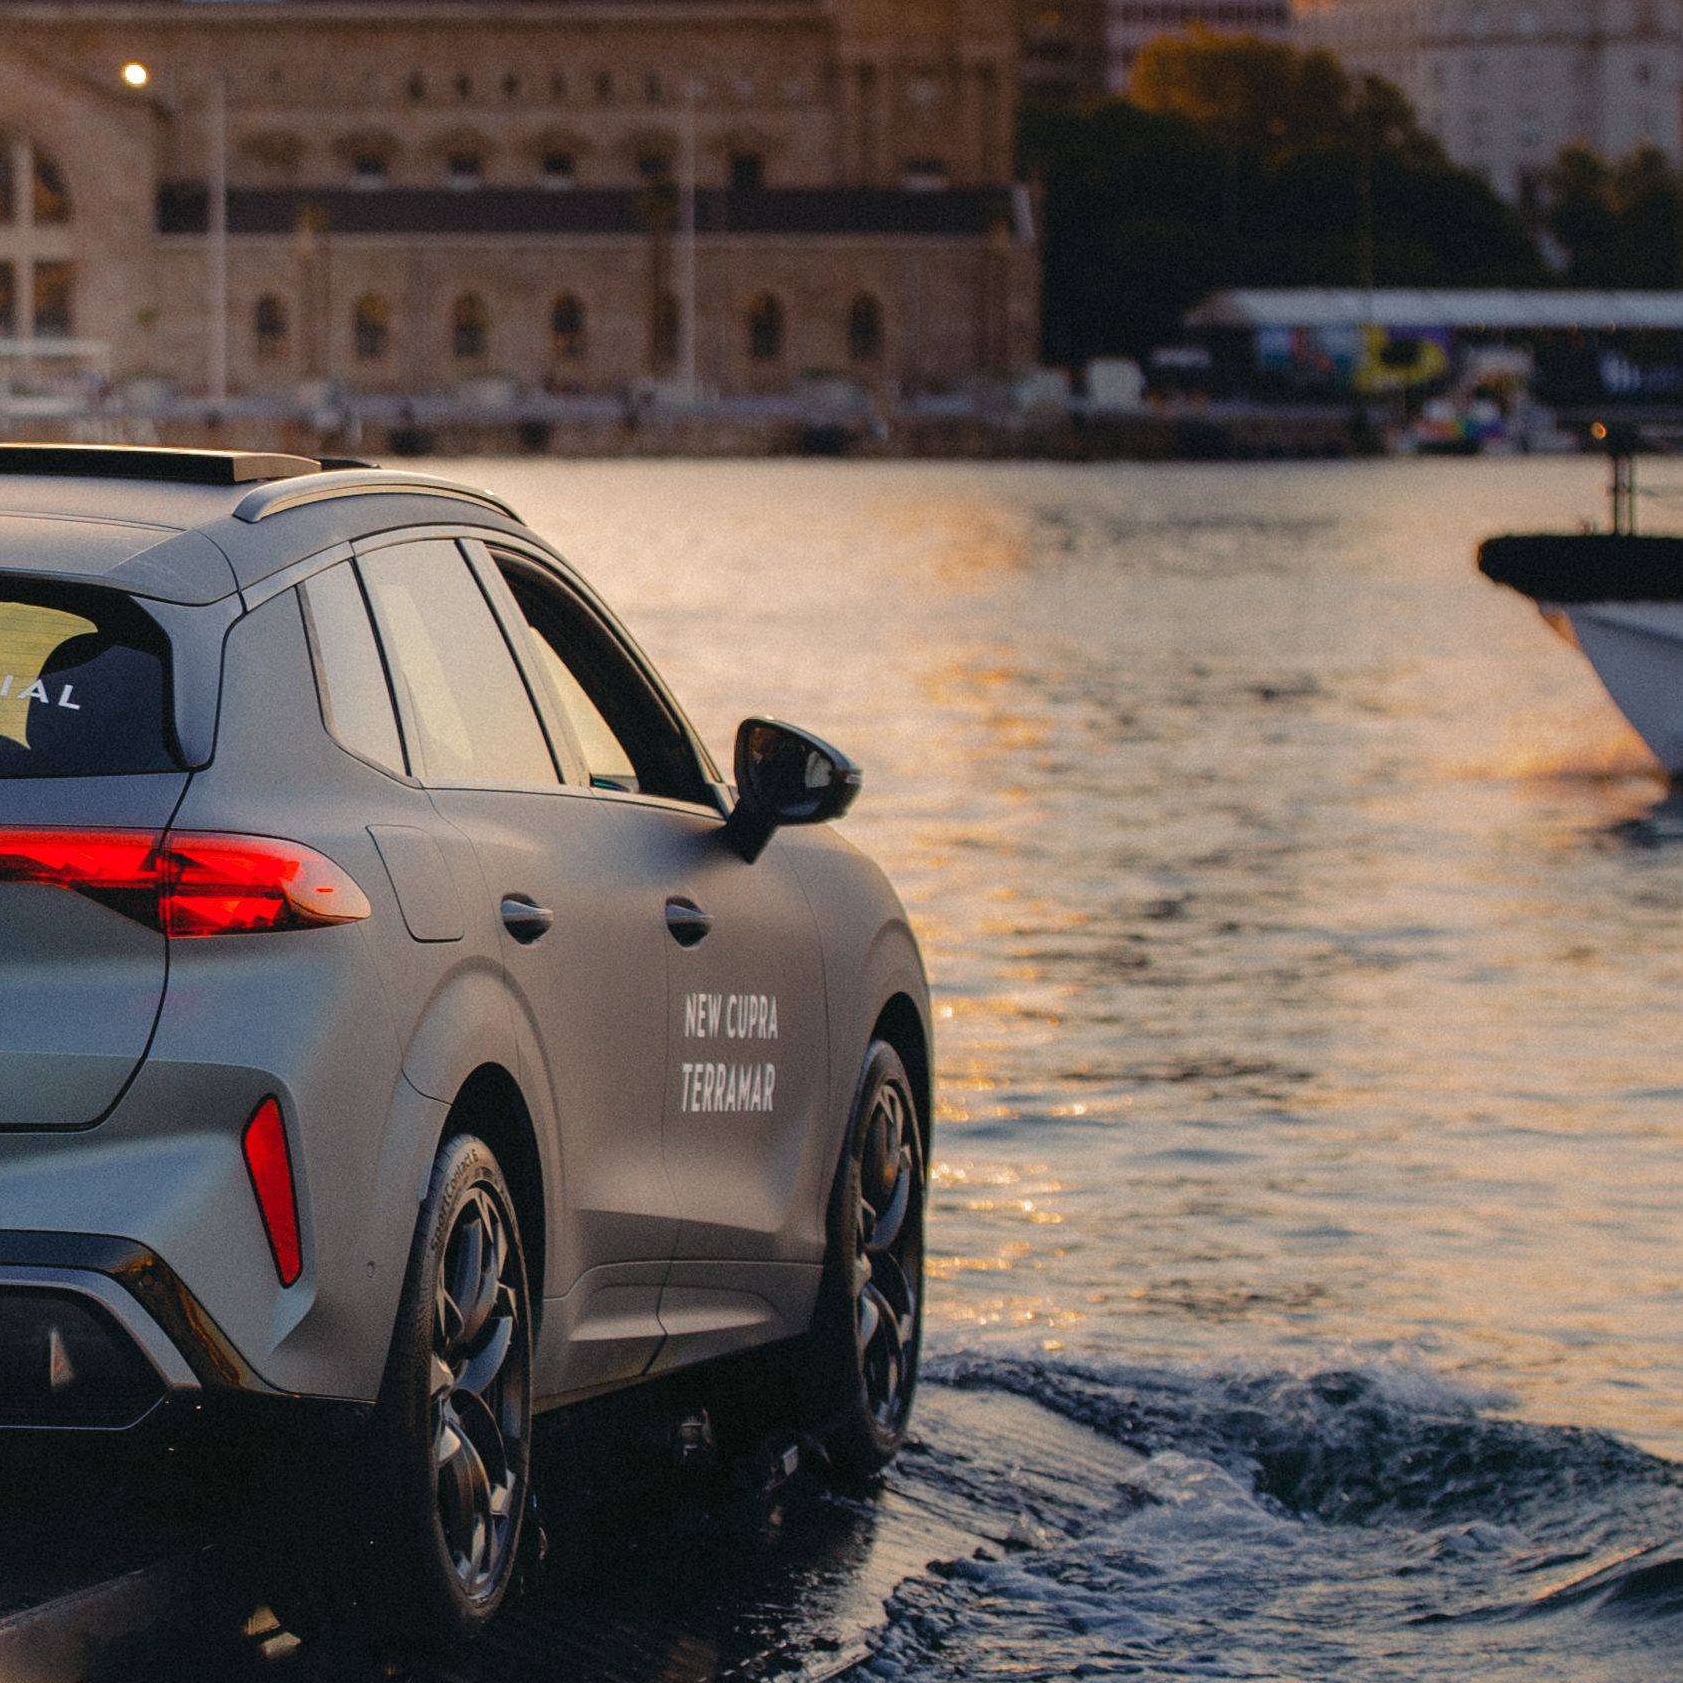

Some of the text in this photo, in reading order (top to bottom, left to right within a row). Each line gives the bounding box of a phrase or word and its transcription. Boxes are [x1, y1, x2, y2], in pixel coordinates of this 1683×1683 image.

[684, 992, 779, 1039] NEW CUPRA
[681, 1062, 777, 1113] TERRAMAR
